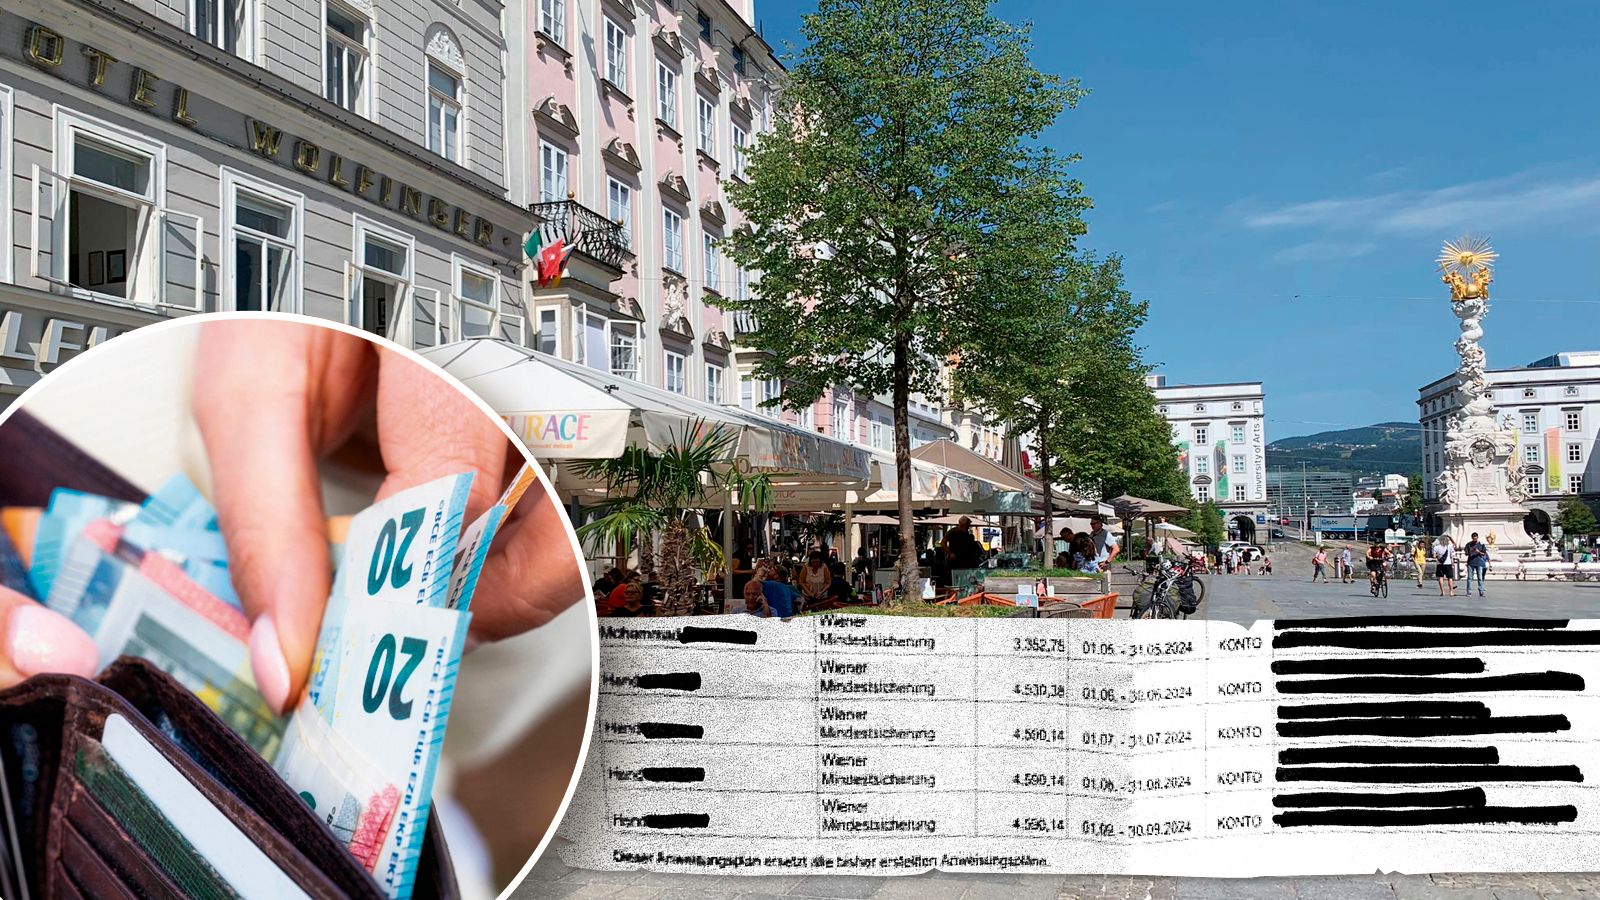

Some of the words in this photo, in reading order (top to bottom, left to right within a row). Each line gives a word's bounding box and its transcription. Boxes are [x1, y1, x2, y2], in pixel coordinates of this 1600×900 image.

[29, 25, 198, 125] OTEL
[247, 118, 495, 246] WOLFINGER
[1253, 423, 1261, 443] Arts
[1254, 444, 1261, 453] of
[1254, 454, 1263, 500] University
[367, 507, 426, 596] 20
[1218, 636, 1263, 652] KONTO
[362, 633, 428, 720] 20
[1218, 681, 1262, 696] KONTO
[1217, 725, 1263, 739] KONTO
[1217, 770, 1263, 786] KONTO
[1217, 814, 1262, 830] KONTO
